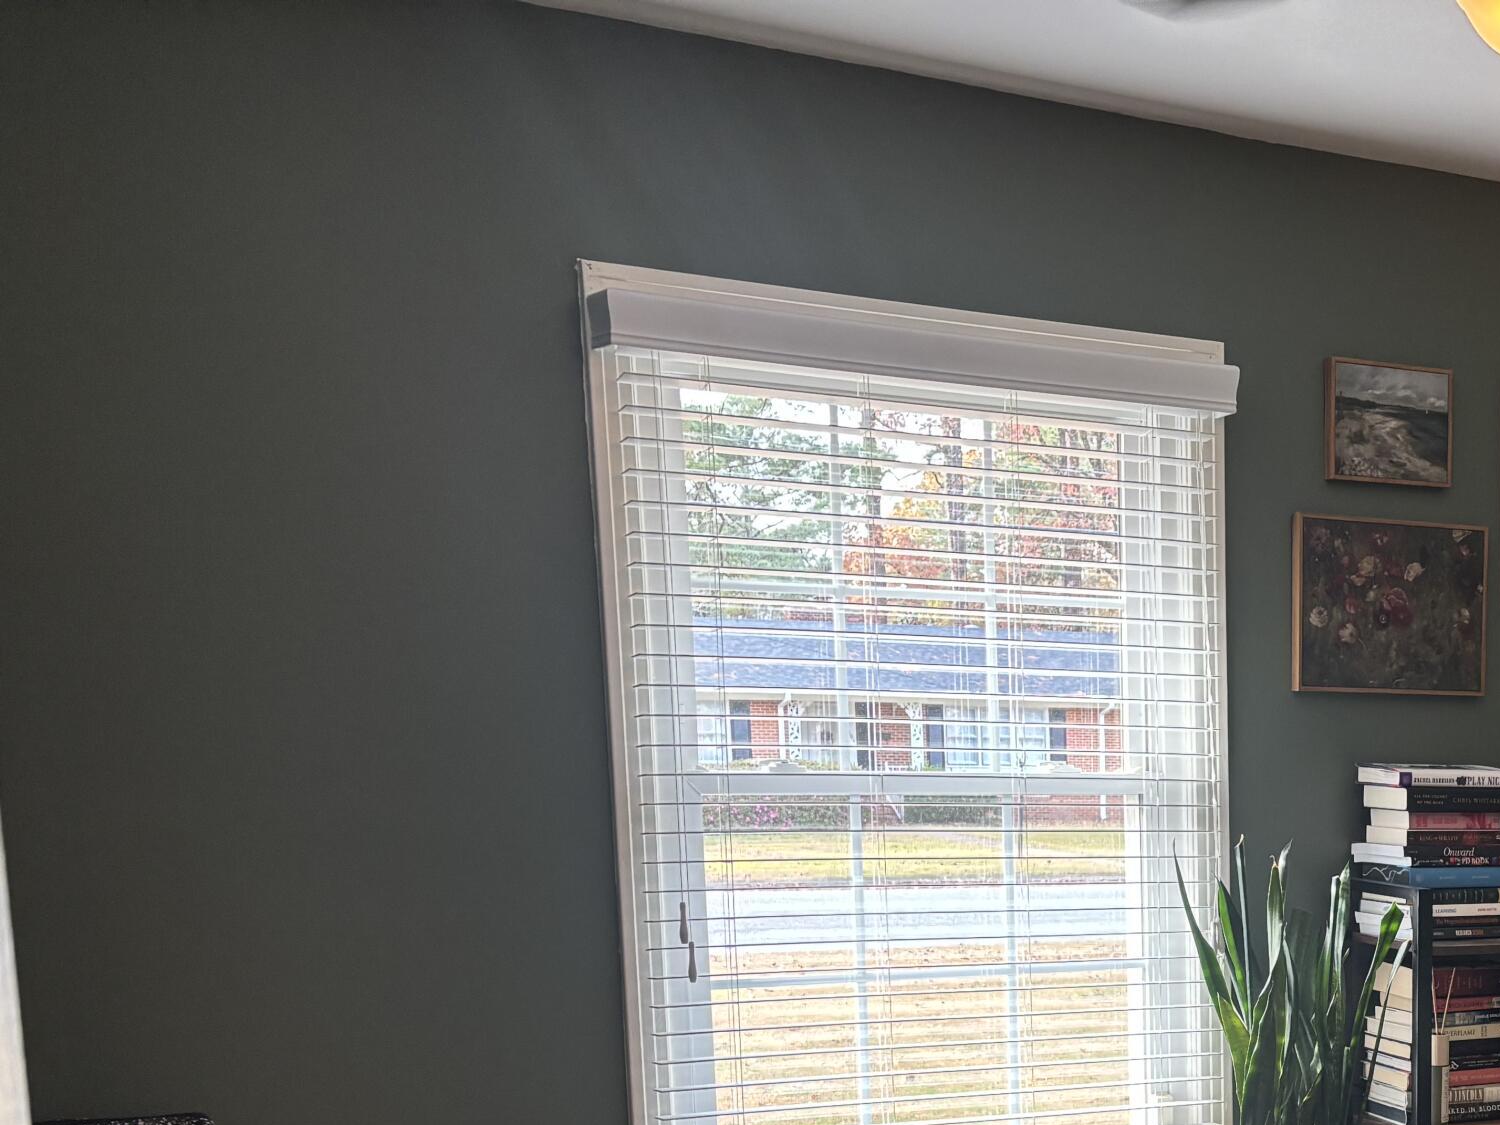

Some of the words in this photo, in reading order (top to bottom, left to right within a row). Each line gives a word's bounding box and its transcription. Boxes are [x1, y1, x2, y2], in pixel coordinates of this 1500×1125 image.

[1467, 776, 1486, 786] PLAY
[1443, 846, 1475, 857] Onward
[1471, 856, 1489, 864] BOOK
